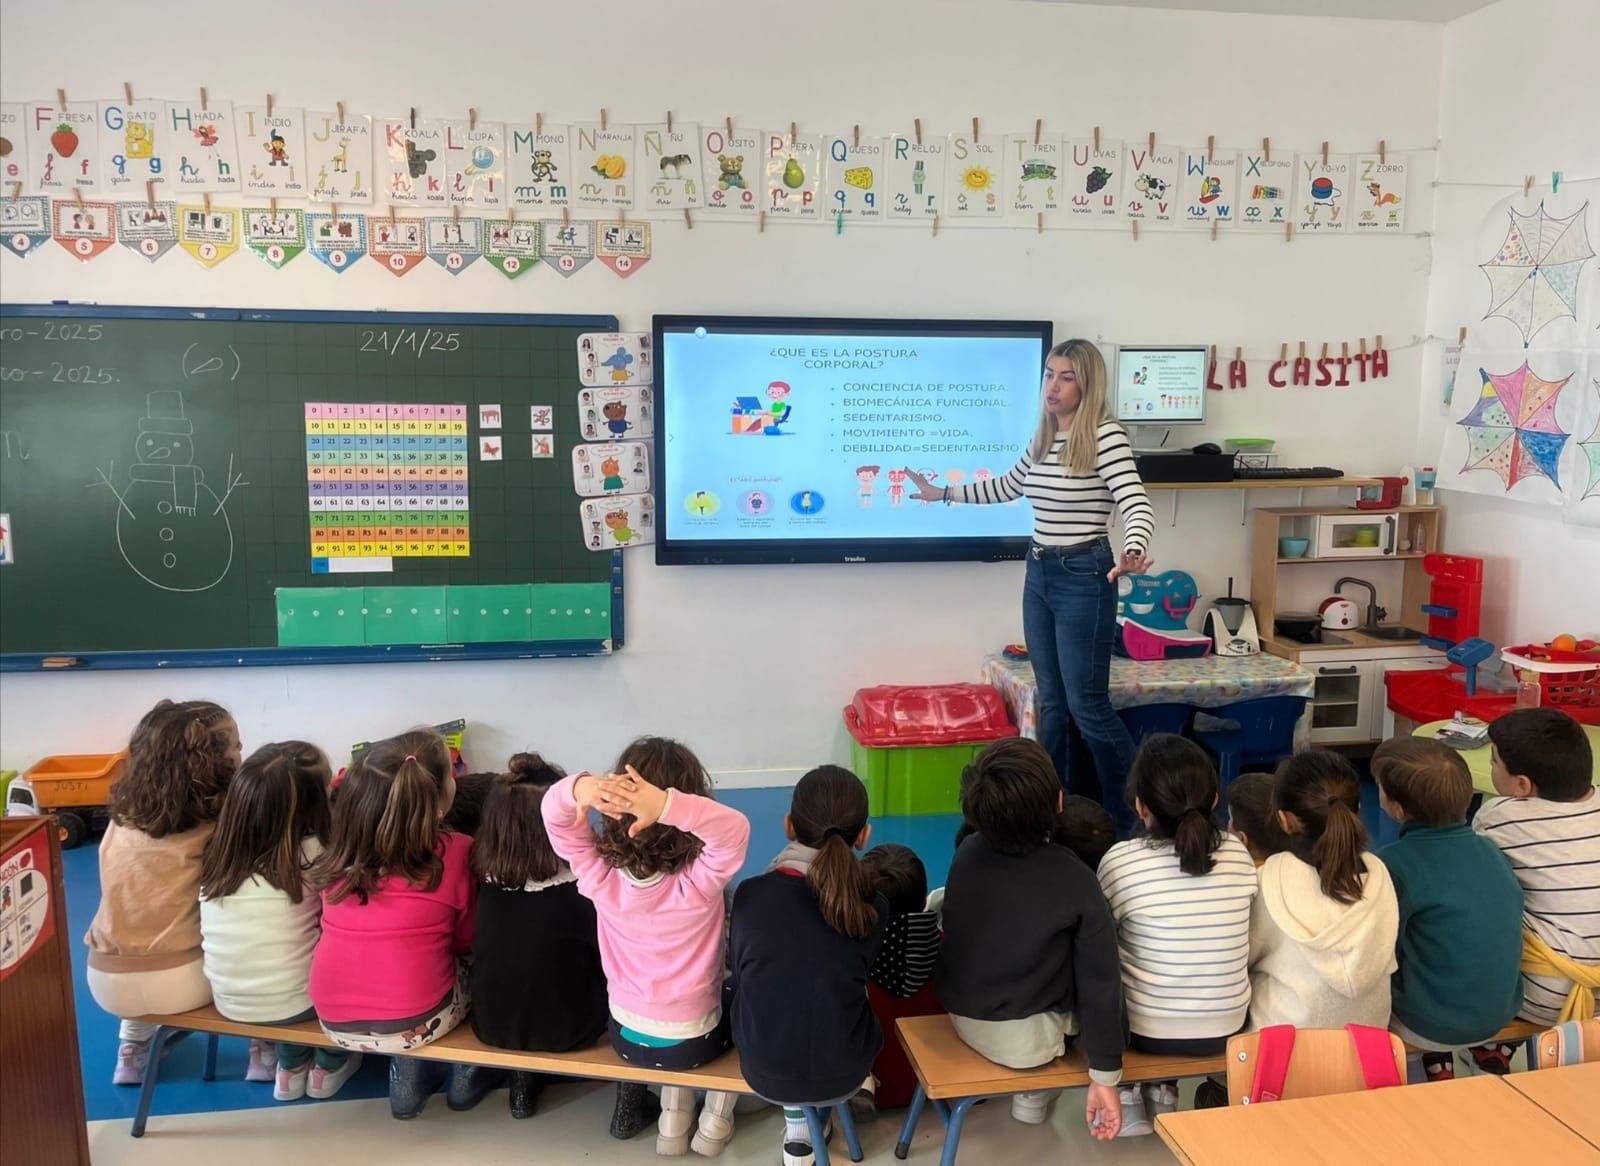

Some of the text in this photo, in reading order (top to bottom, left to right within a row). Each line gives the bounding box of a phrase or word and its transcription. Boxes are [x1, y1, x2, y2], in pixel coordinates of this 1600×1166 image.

[35, 108, 93, 131] F FRESA
[105, 107, 156, 130] G GATO
[172, 108, 224, 131] H HADA
[248, 112, 291, 137] I INDIO
[314, 119, 367, 142] J JIRAFA
[386, 125, 439, 147] K KOALA
[448, 127, 494, 150] L LUPA
[514, 131, 564, 153] M MONO
[579, 129, 632, 151] N NARANJA
[644, 131, 662, 156] Ñ
[707, 132, 755, 154] O OSITO
[771, 137, 814, 158] P PERA
[832, 140, 879, 162] Q QUESO
[895, 139, 941, 160] R RELOJ
[954, 138, 992, 160] S SOL
[1014, 141, 1056, 161] T TREN
[1074, 145, 1116, 166] U UVAS
[1132, 150, 1173, 171] V VACA
[7, 164, 18, 176] e
[80, 160, 89, 175] f
[149, 157, 162, 174] g
[218, 160, 230, 174] h
[1188, 156, 1204, 176] W
[1246, 156, 1261, 176] X
[1304, 161, 1317, 180] Y
[1360, 161, 1403, 181] Z ZORRO
[428, 176, 439, 191] k
[616, 185, 626, 196] n
[550, 185, 567, 197] m
[742, 192, 752, 202] o
[802, 191, 813, 206] p
[864, 192, 874, 207] q
[927, 195, 935, 206] r
[986, 193, 995, 204] s
[1104, 195, 1112, 206] u
[1158, 203, 1168, 213] v
[1217, 206, 1229, 216] w
[1273, 207, 1283, 217] x
[1331, 206, 1341, 220] y
[18, 238, 24, 246] 4
[81, 242, 87, 250] 5
[147, 243, 153, 251] 6
[205, 248, 211, 256] 7
[273, 250, 279, 258] 8
[335, 255, 341, 263] 9
[393, 258, 404, 266] 10
[506, 261, 517, 269] 12
[360, 328, 460, 358] 21/1/25
[770, 348, 918, 359] ¿QUE ES LA POSTURA
[804, 360, 884, 369] CORPORAL?
[1207, 348, 1390, 390] LA CASITA
[843, 383, 1009, 392] CONCIENCIA DE POSTURA.
[843, 396, 932, 407] BIOMECÁNICA
[843, 414, 946, 422] SEDENTARISMO.
[454, 423, 462, 431] 19
[843, 428, 925, 438] MOVIMIENTO
[393, 468, 402, 476] 45
[394, 498, 403, 506] 65
